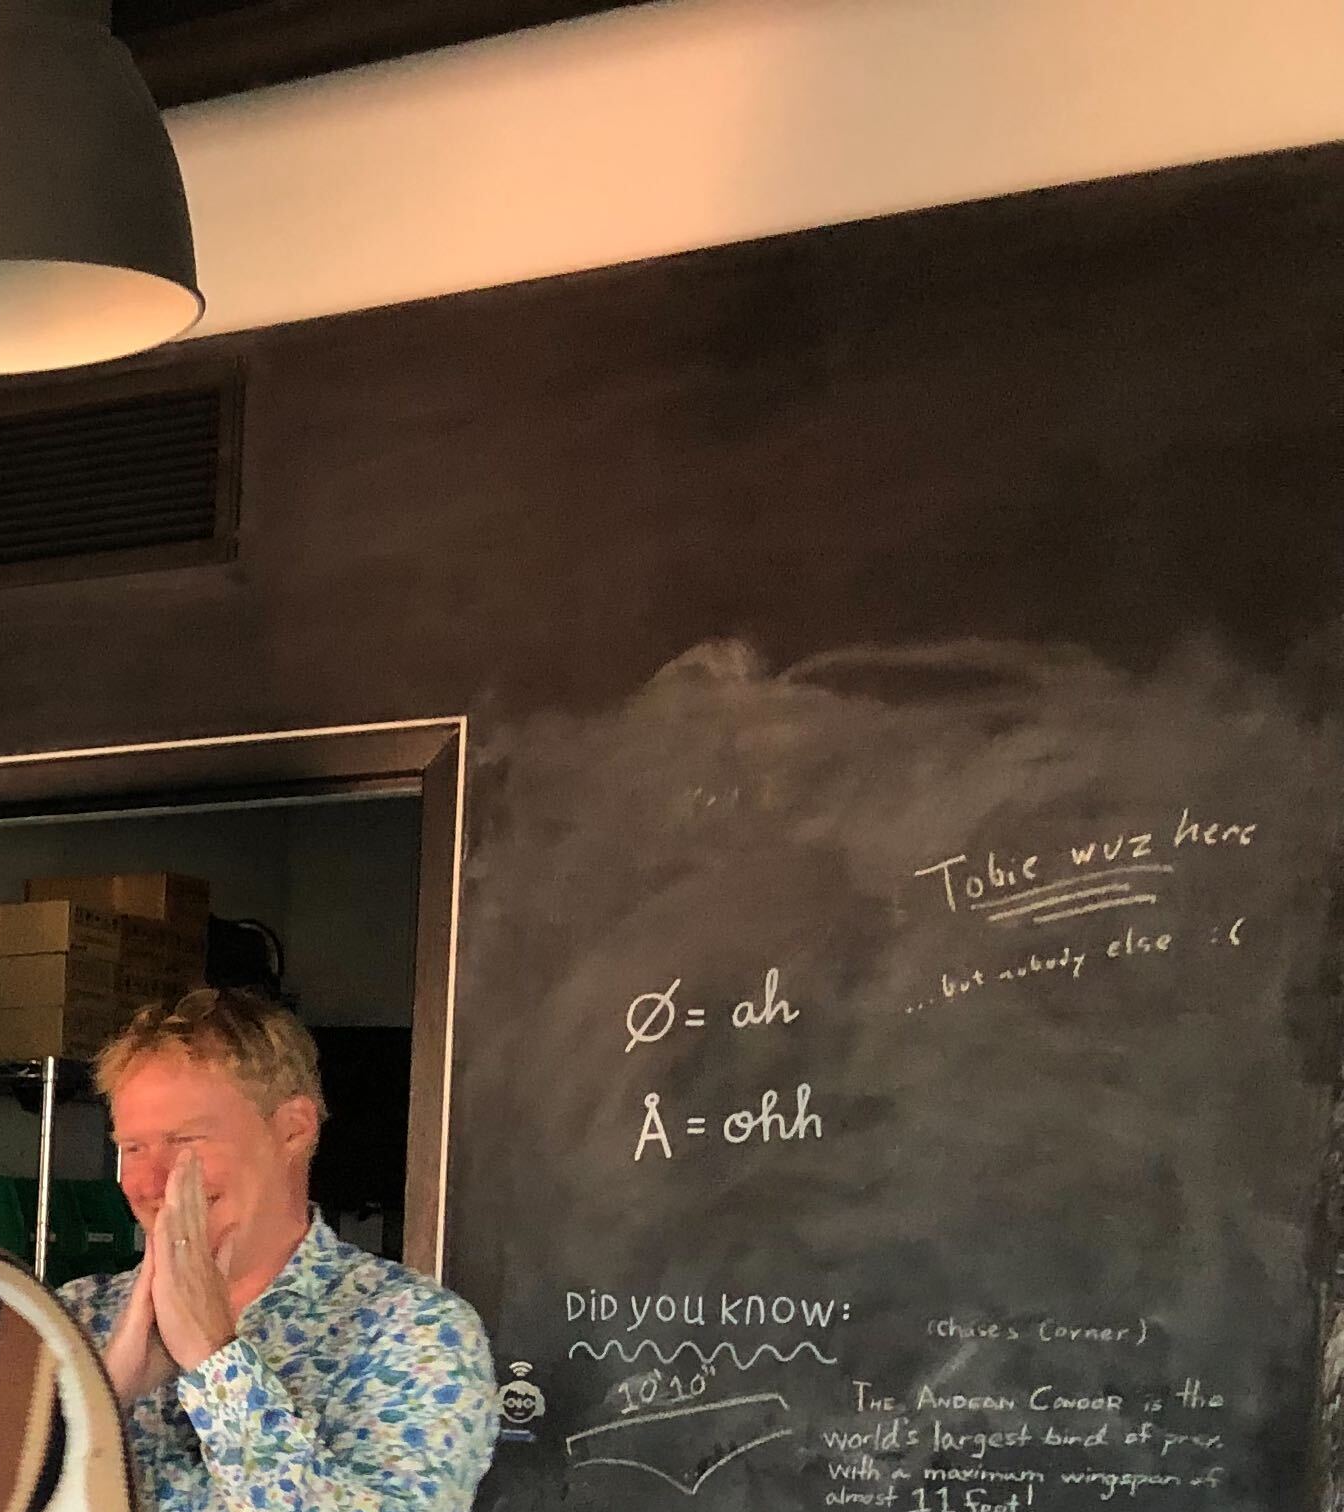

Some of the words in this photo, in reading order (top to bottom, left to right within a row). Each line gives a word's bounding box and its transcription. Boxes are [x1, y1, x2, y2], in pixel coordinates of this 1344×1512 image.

[914, 852, 1038, 912] Tobie
[1174, 808, 1258, 848] here
[999, 947, 1086, 980] nobody
[1106, 927, 1174, 958] else
[731, 967, 801, 1029] ah
[723, 1082, 823, 1144] ohh
[626, 1294, 706, 1332] you
[1144, 1397, 1164, 1413] is
[1175, 1377, 1225, 1409] the
[823, 1417, 919, 1451] world's
[932, 1419, 1034, 1459] largest
[1043, 1425, 1109, 1448] bird
[1124, 1420, 1154, 1446] of
[825, 1485, 899, 1508] almost
[890, 1468, 911, 1481] a
[922, 1463, 1046, 1484] maximum
[1059, 1466, 1184, 1502] wingspan
[1189, 1466, 1225, 1490] of
